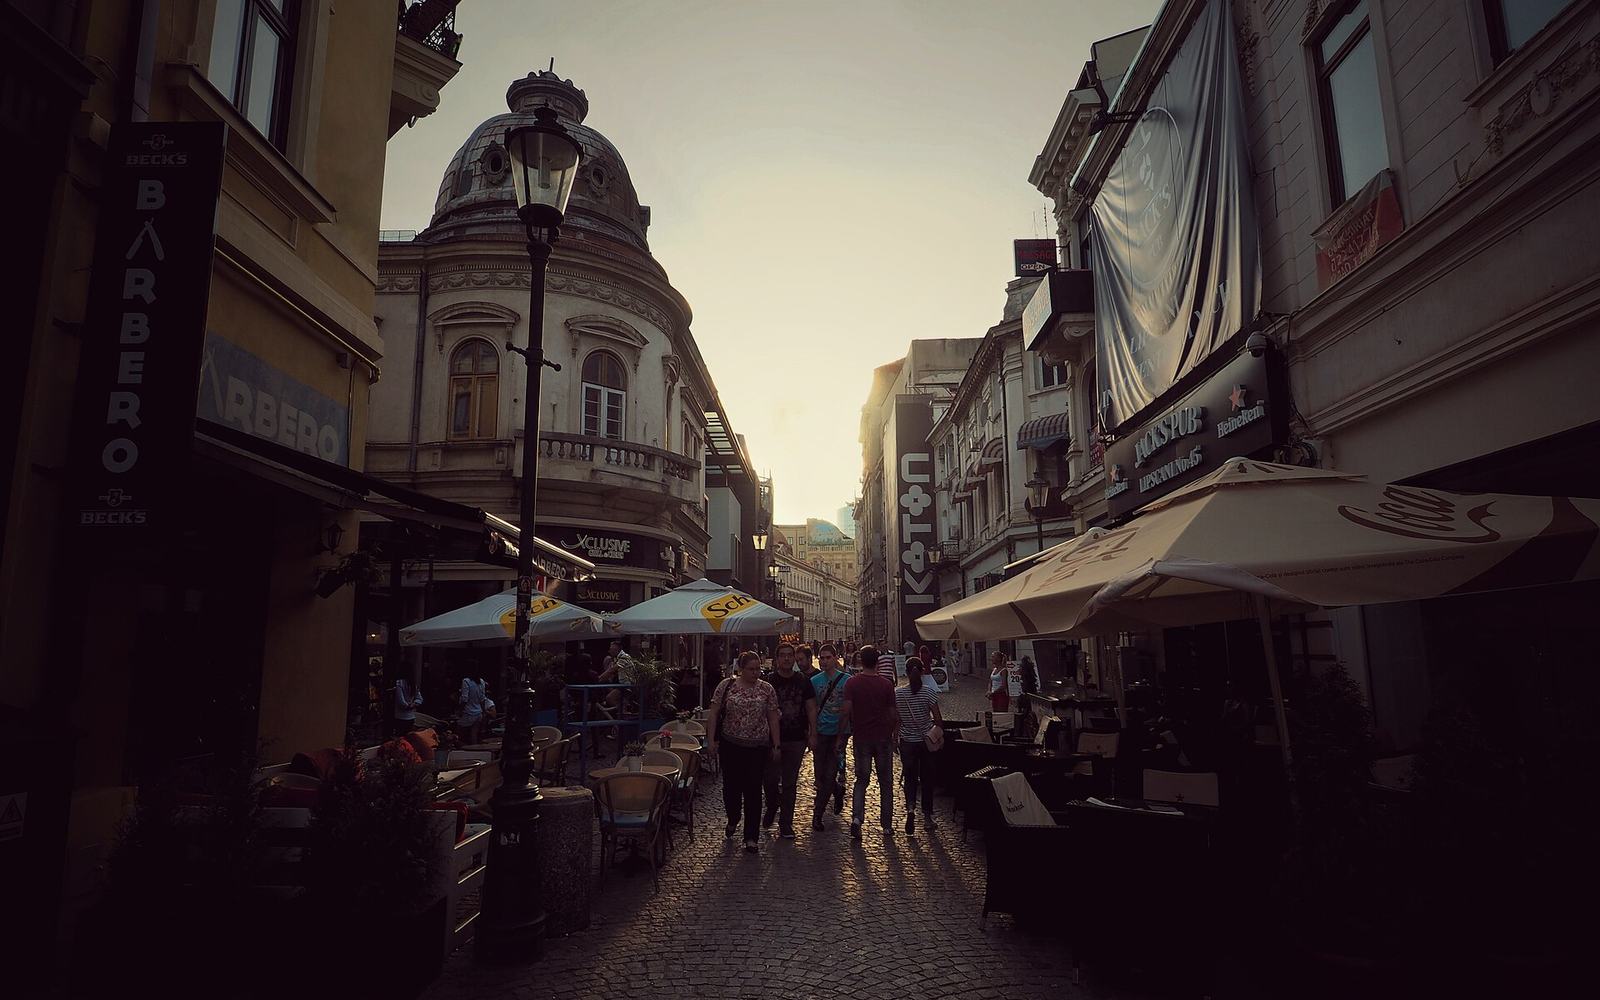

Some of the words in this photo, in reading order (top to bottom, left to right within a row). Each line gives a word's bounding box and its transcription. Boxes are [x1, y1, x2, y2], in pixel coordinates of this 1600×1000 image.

[102, 178, 167, 473] BARBERO
[1169, 406, 1204, 440] PUB
[1216, 404, 1265, 438] Heineken
[560, 533, 632, 553] XCLUSIVE
[706, 594, 751, 618] Sch
